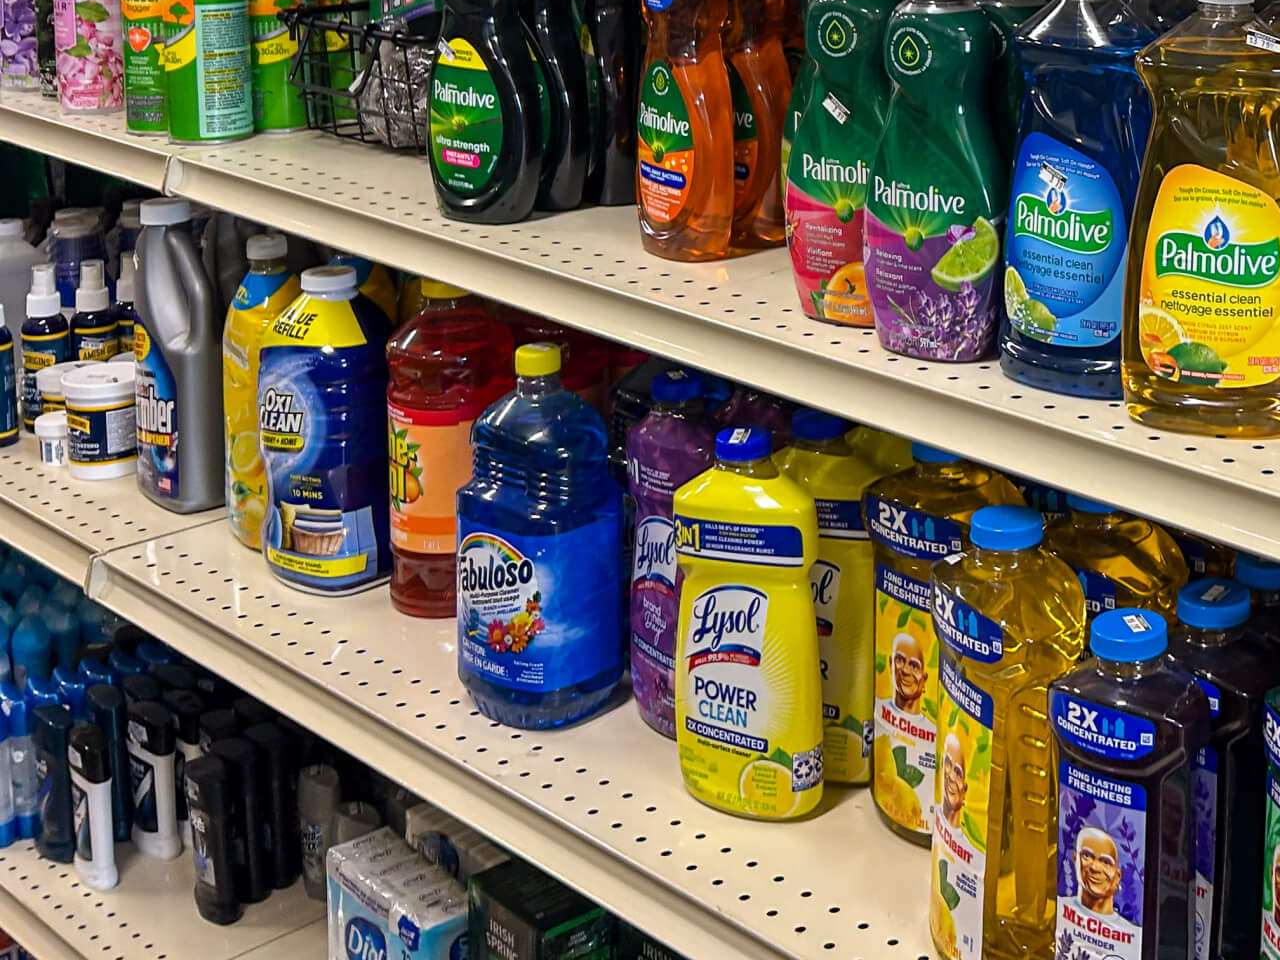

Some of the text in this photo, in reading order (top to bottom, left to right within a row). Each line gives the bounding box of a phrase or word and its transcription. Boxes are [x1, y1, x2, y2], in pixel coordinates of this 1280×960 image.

[434, 79, 496, 109] Palmolive
[640, 101, 690, 137] Palmolive
[453, 139, 491, 154] strength
[874, 175, 966, 215] Palmolive
[1016, 201, 1109, 244] Palmolive
[875, 249, 903, 262] Relaxing
[1022, 248, 1094, 271] essential clean
[1161, 239, 1276, 276] Palmolive
[875, 268, 904, 282] Relaxant
[1053, 268, 1105, 285] essentiel
[1160, 299, 1273, 317] nettoyage essentiel
[1171, 289, 1261, 305] essential clean
[273, 321, 309, 340] REFILL!
[83, 347, 105, 361] AMISH
[265, 389, 292, 412] OXI
[302, 490, 323, 500] MINS
[878, 501, 909, 535] 2X
[637, 525, 674, 573] Lysol
[675, 519, 701, 551] 3IN1
[871, 519, 948, 555] CONCENTRATED
[883, 569, 903, 586] LONG
[693, 594, 760, 649] Lysol
[934, 585, 956, 627] 2X
[694, 675, 757, 712] POWER
[942, 671, 982, 718] FRESHNESS
[954, 673, 983, 705] LASTING
[698, 699, 748, 729] CLEAN
[881, 705, 935, 743] Mr.Clean
[1067, 700, 1099, 733] 2X
[687, 719, 765, 751] 2X CONCENTRATED
[1057, 715, 1137, 751] CONCENTRATED
[1068, 765, 1133, 795] LONG LASTING
[1068, 775, 1132, 806] FRESHNESS
[489, 919, 516, 945] IRISH
[1063, 903, 1134, 944] Mr.Clean
[1073, 928, 1115, 952] LAVENDER
